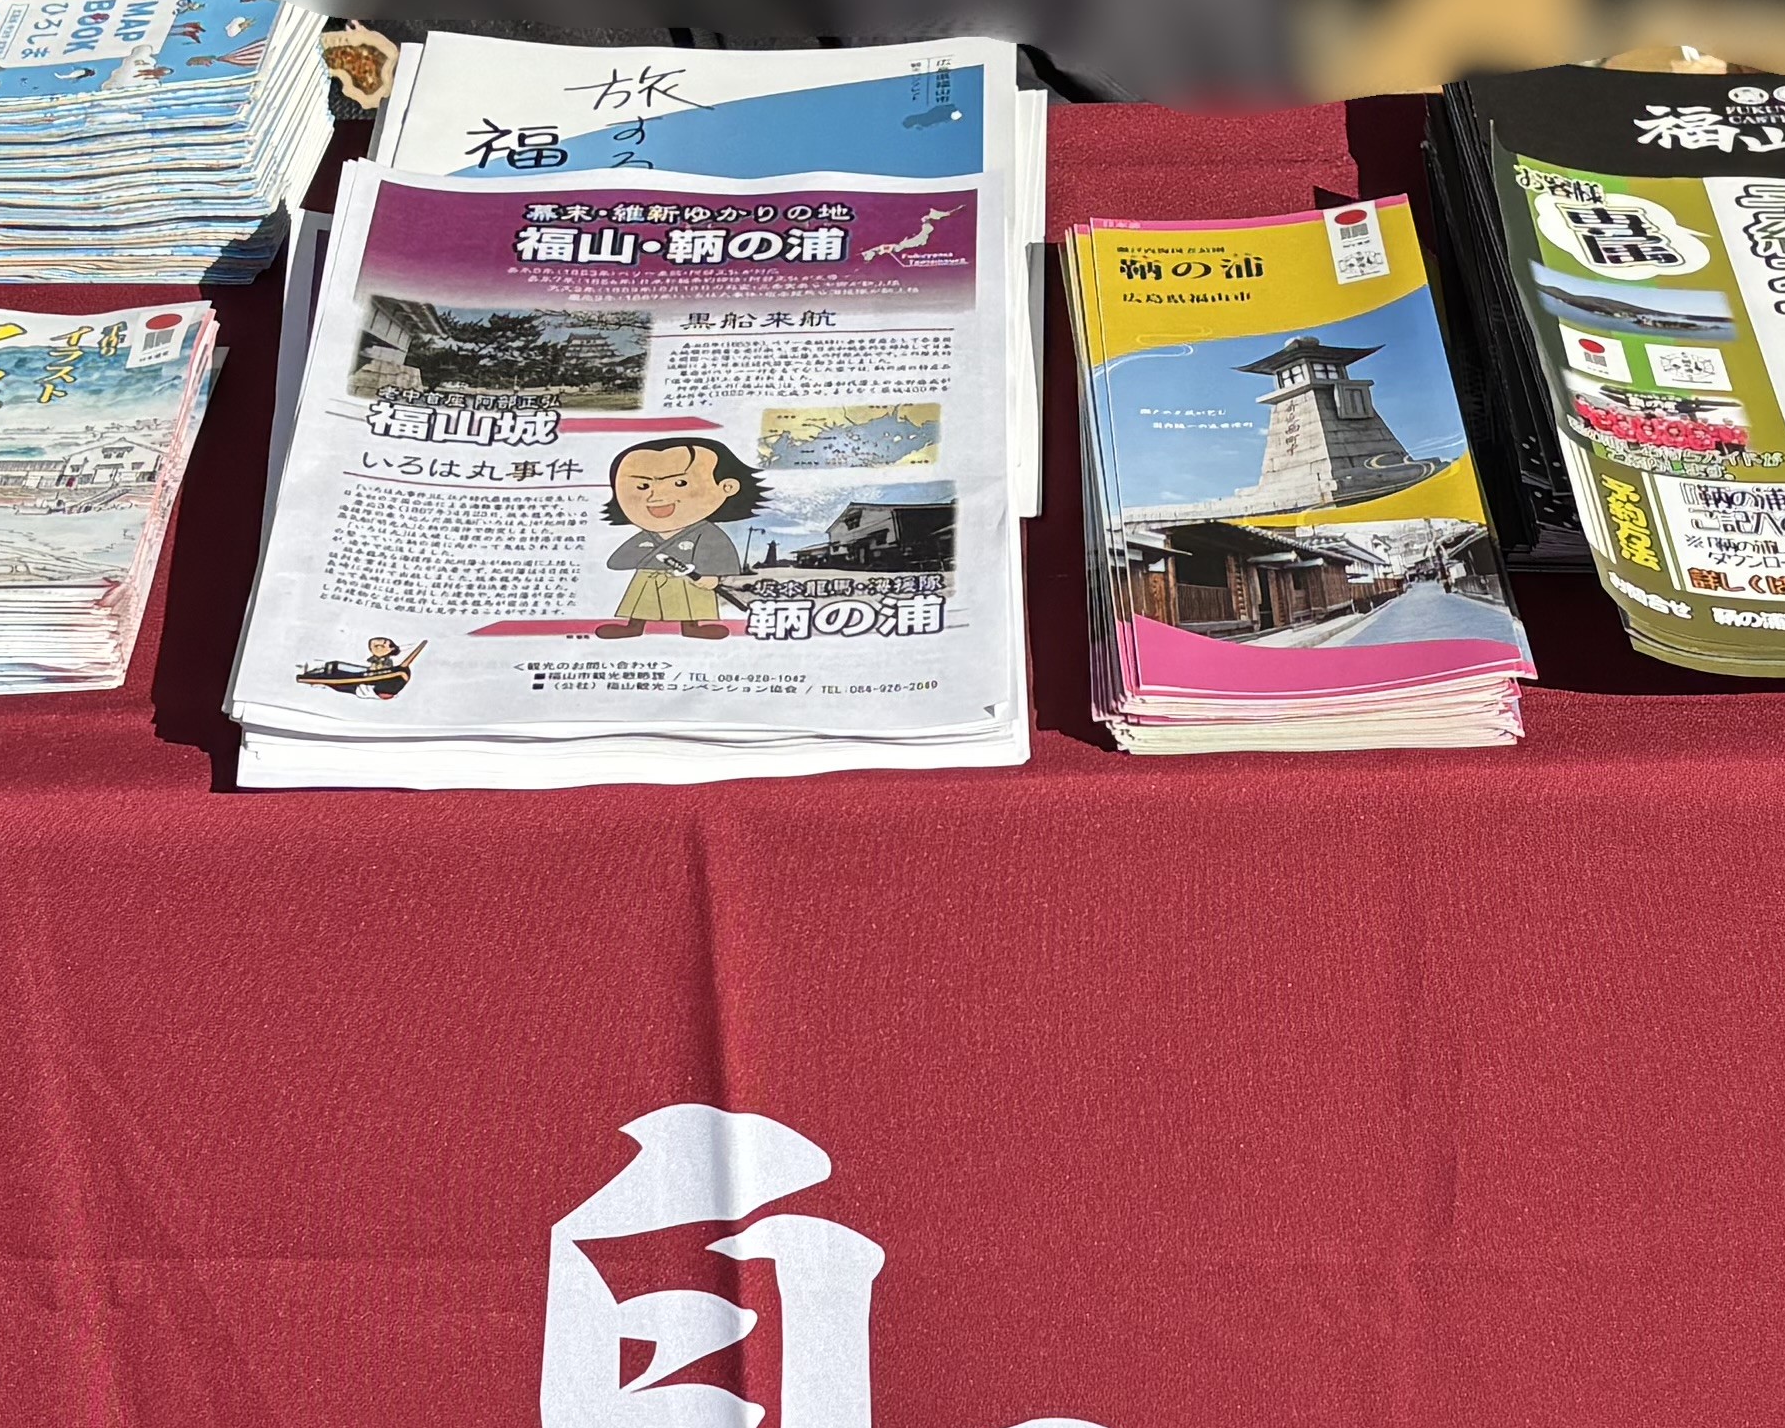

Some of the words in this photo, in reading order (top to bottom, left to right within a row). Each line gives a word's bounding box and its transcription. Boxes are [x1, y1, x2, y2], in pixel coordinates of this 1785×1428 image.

[21, 2, 69, 60] ひろしま
[63, 0, 116, 55] BOOK
[114, 0, 159, 44] MAP
[1513, 164, 1607, 206] お客様
[523, 202, 855, 224] 幕末・維新ゆかりの地
[517, 227, 845, 265] 福山・鞆の浦
[1120, 256, 1264, 281] 鞆の浦
[679, 309, 837, 330] 黒船来航
[1122, 292, 1251, 304] 広島県福山市
[36, 327, 100, 404] イラスト
[367, 401, 561, 446] 福山城
[362, 451, 584, 481] いろは丸事件
[1600, 477, 1661, 572] 予約方法
[746, 595, 946, 639] 鞆の浦
